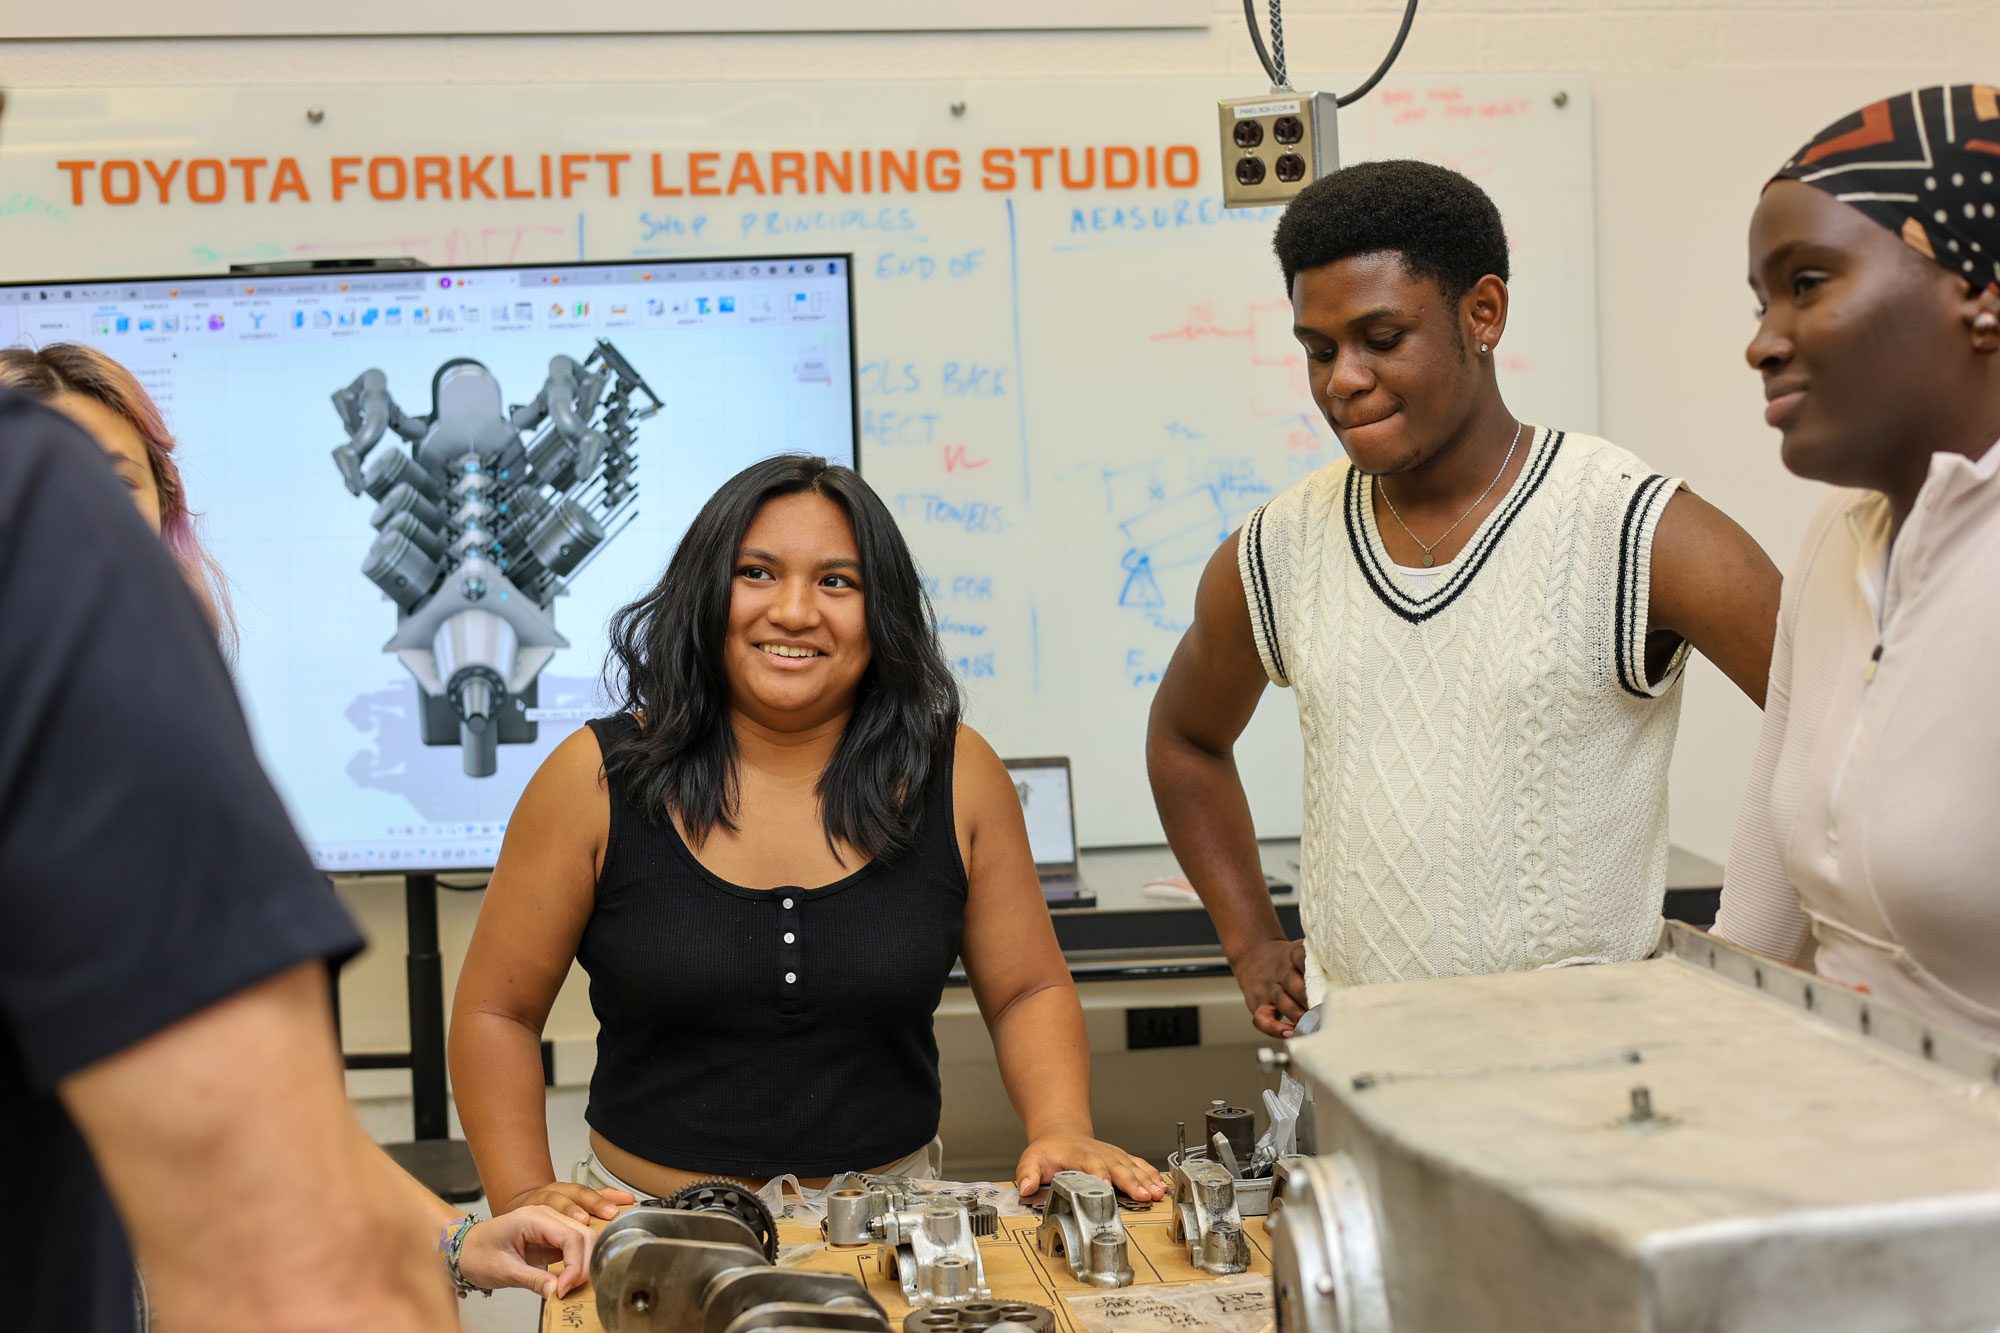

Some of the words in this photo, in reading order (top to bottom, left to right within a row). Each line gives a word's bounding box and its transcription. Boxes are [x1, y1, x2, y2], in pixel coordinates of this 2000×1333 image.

[57, 156, 311, 206] TOYOTA
[330, 152, 631, 201] FORKLIFT
[651, 148, 962, 197] LEARNING
[981, 144, 1201, 192] STUDIO
[639, 210, 708, 241] SHOP
[740, 207, 917, 240] PRINCIPLES
[875, 251, 936, 281] END
[948, 248, 986, 278] OF
